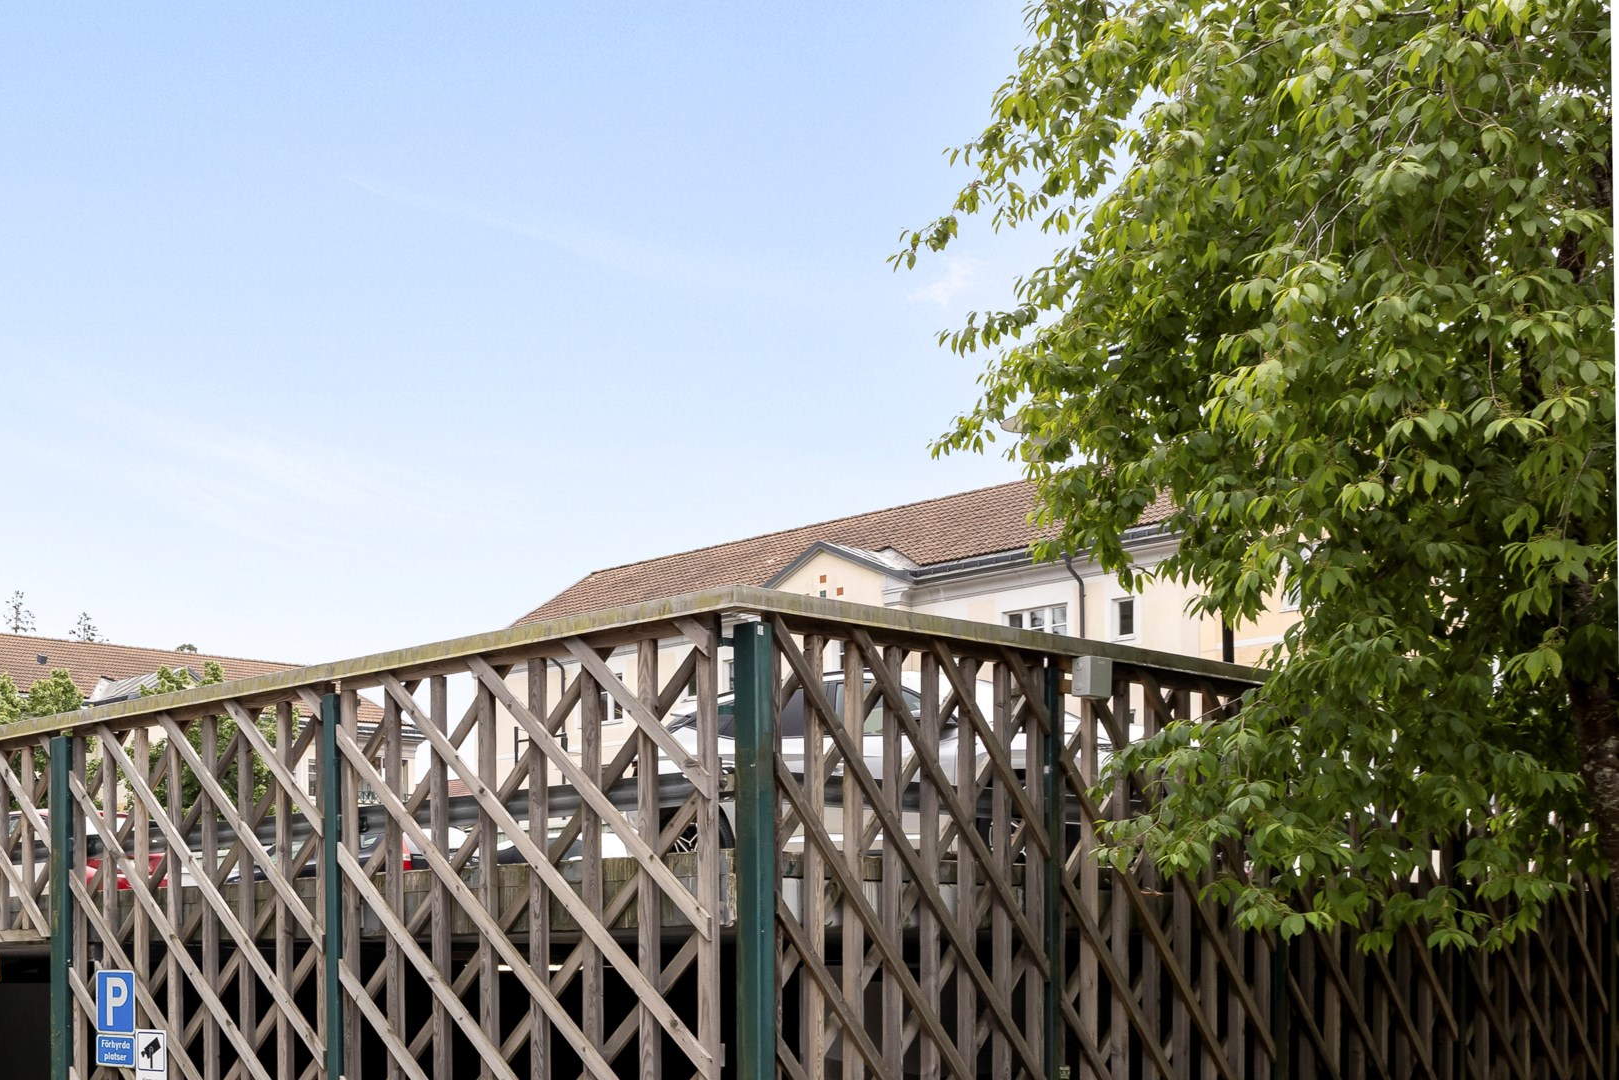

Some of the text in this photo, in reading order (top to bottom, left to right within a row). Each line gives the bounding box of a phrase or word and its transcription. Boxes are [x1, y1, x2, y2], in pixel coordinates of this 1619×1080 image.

[106, 976, 128, 1027] P
[101, 1040, 131, 1050] Förhyrda
[104, 1052, 127, 1061] platser
